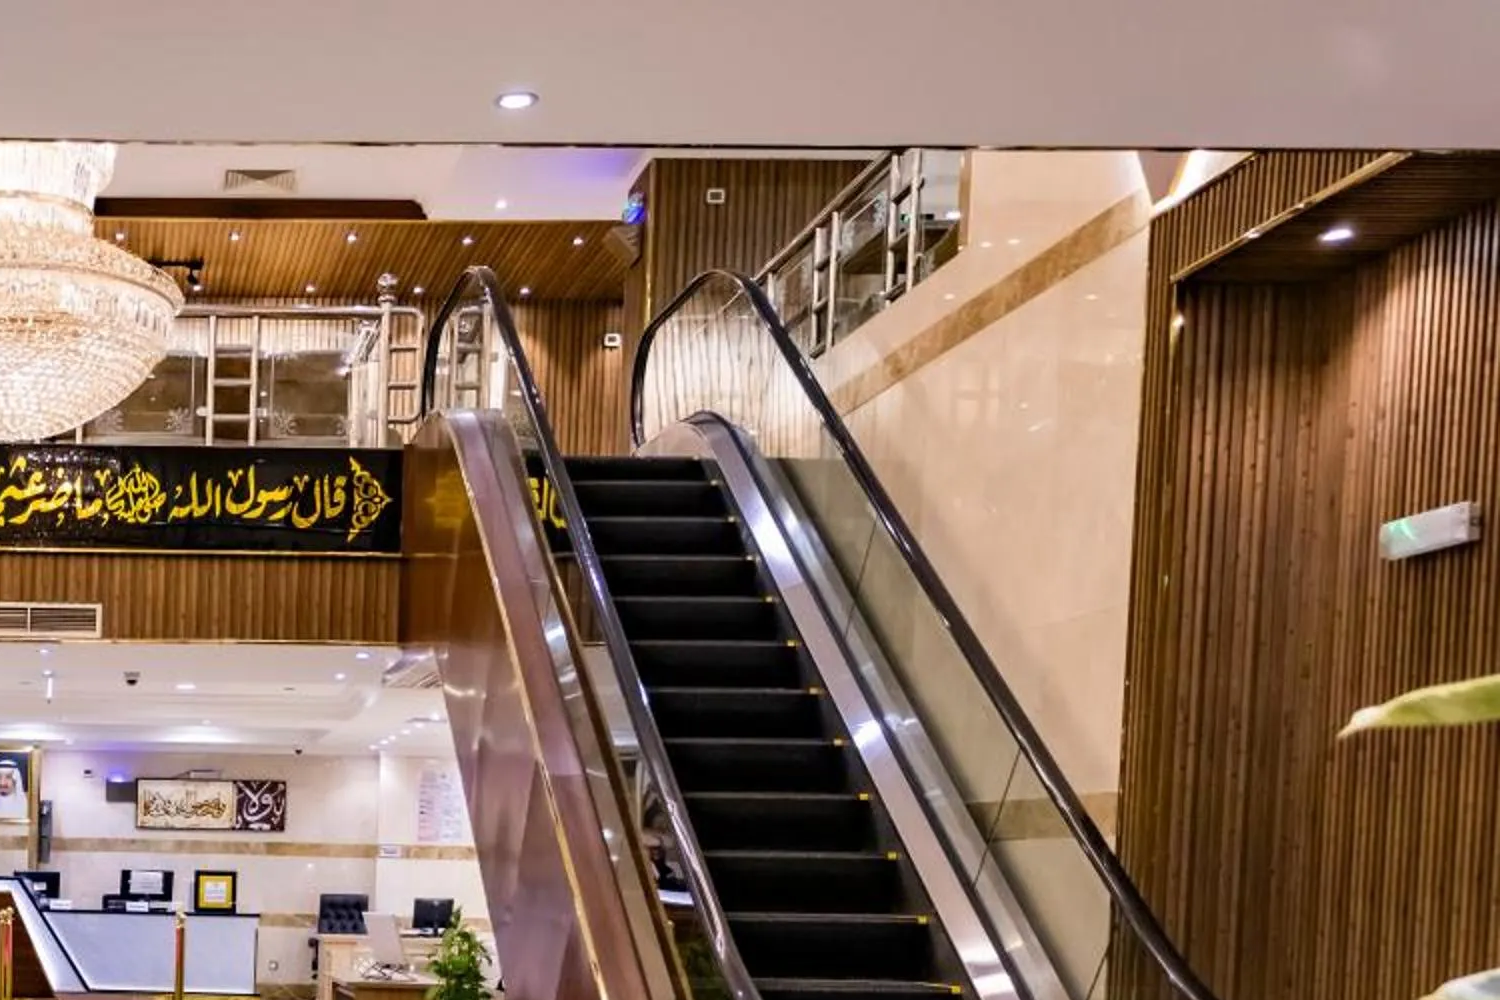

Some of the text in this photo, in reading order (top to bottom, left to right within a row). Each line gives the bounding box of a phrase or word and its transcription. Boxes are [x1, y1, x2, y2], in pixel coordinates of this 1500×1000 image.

[167, 471, 221, 522] الله
[225, 456, 295, 521] رسول
[291, 466, 347, 529] قال
